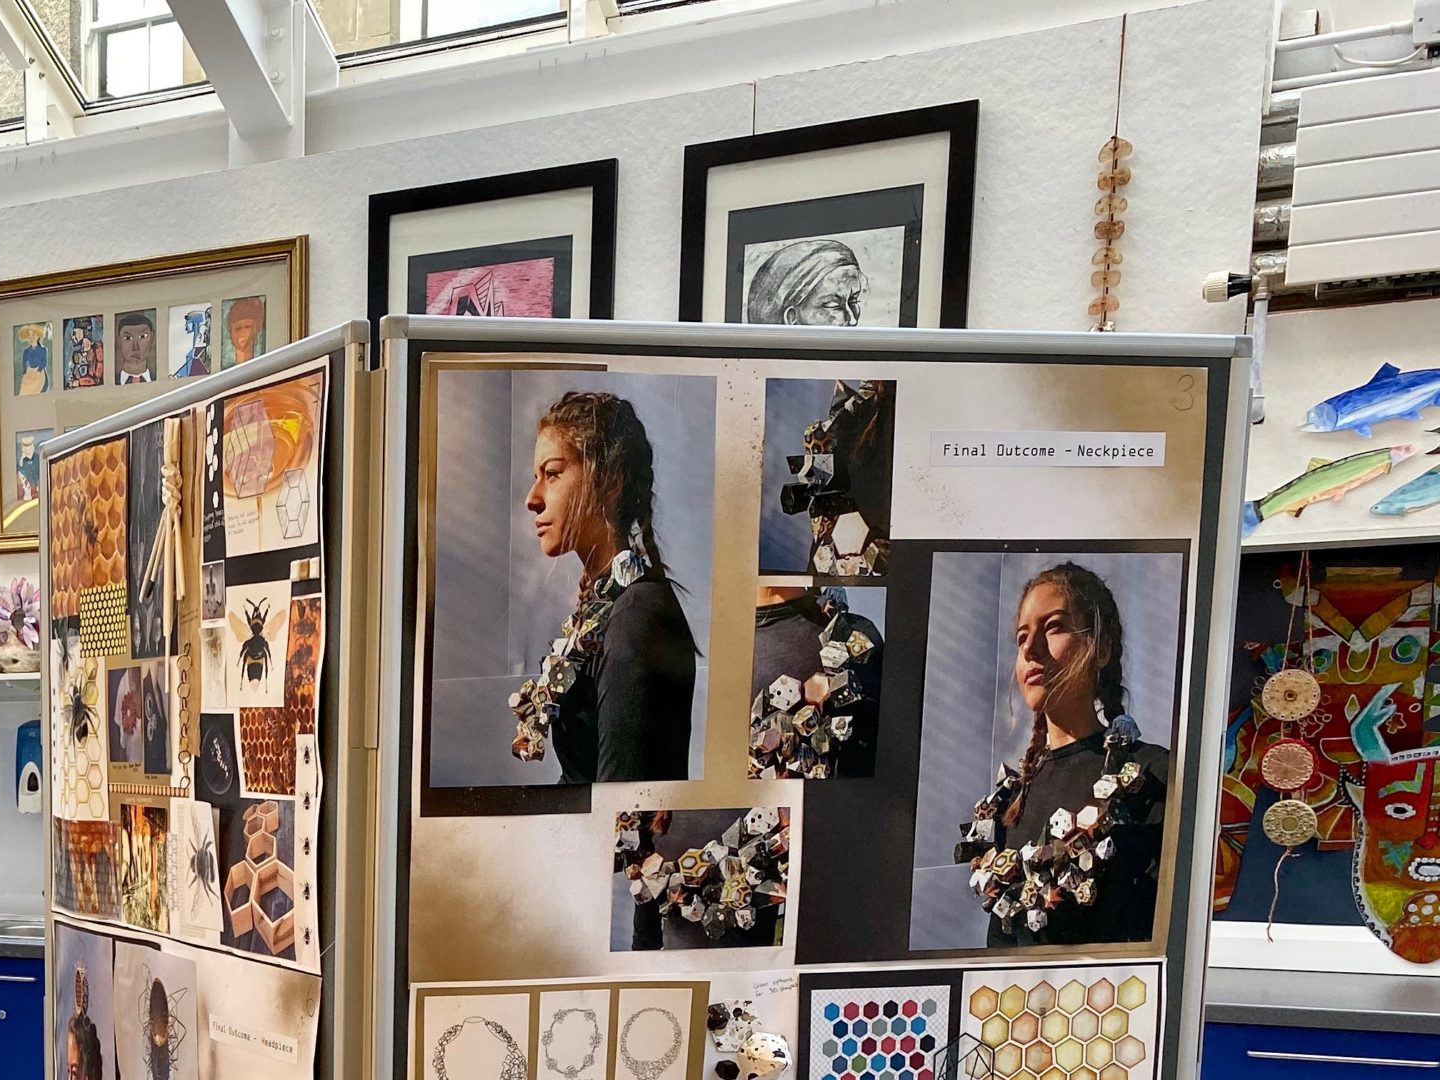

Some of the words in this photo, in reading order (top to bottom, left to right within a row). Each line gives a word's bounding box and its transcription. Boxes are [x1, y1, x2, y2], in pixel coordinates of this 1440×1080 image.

[1173, 374, 1195, 412] 3
[943, 443, 987, 457] Final
[996, 443, 1056, 457] Outcome
[1077, 444, 1155, 460] Neckpiece
[212, 1021, 226, 1034] Final
[228, 1025, 251, 1042] Outcome
[261, 1034, 294, 1055] Headpiece
